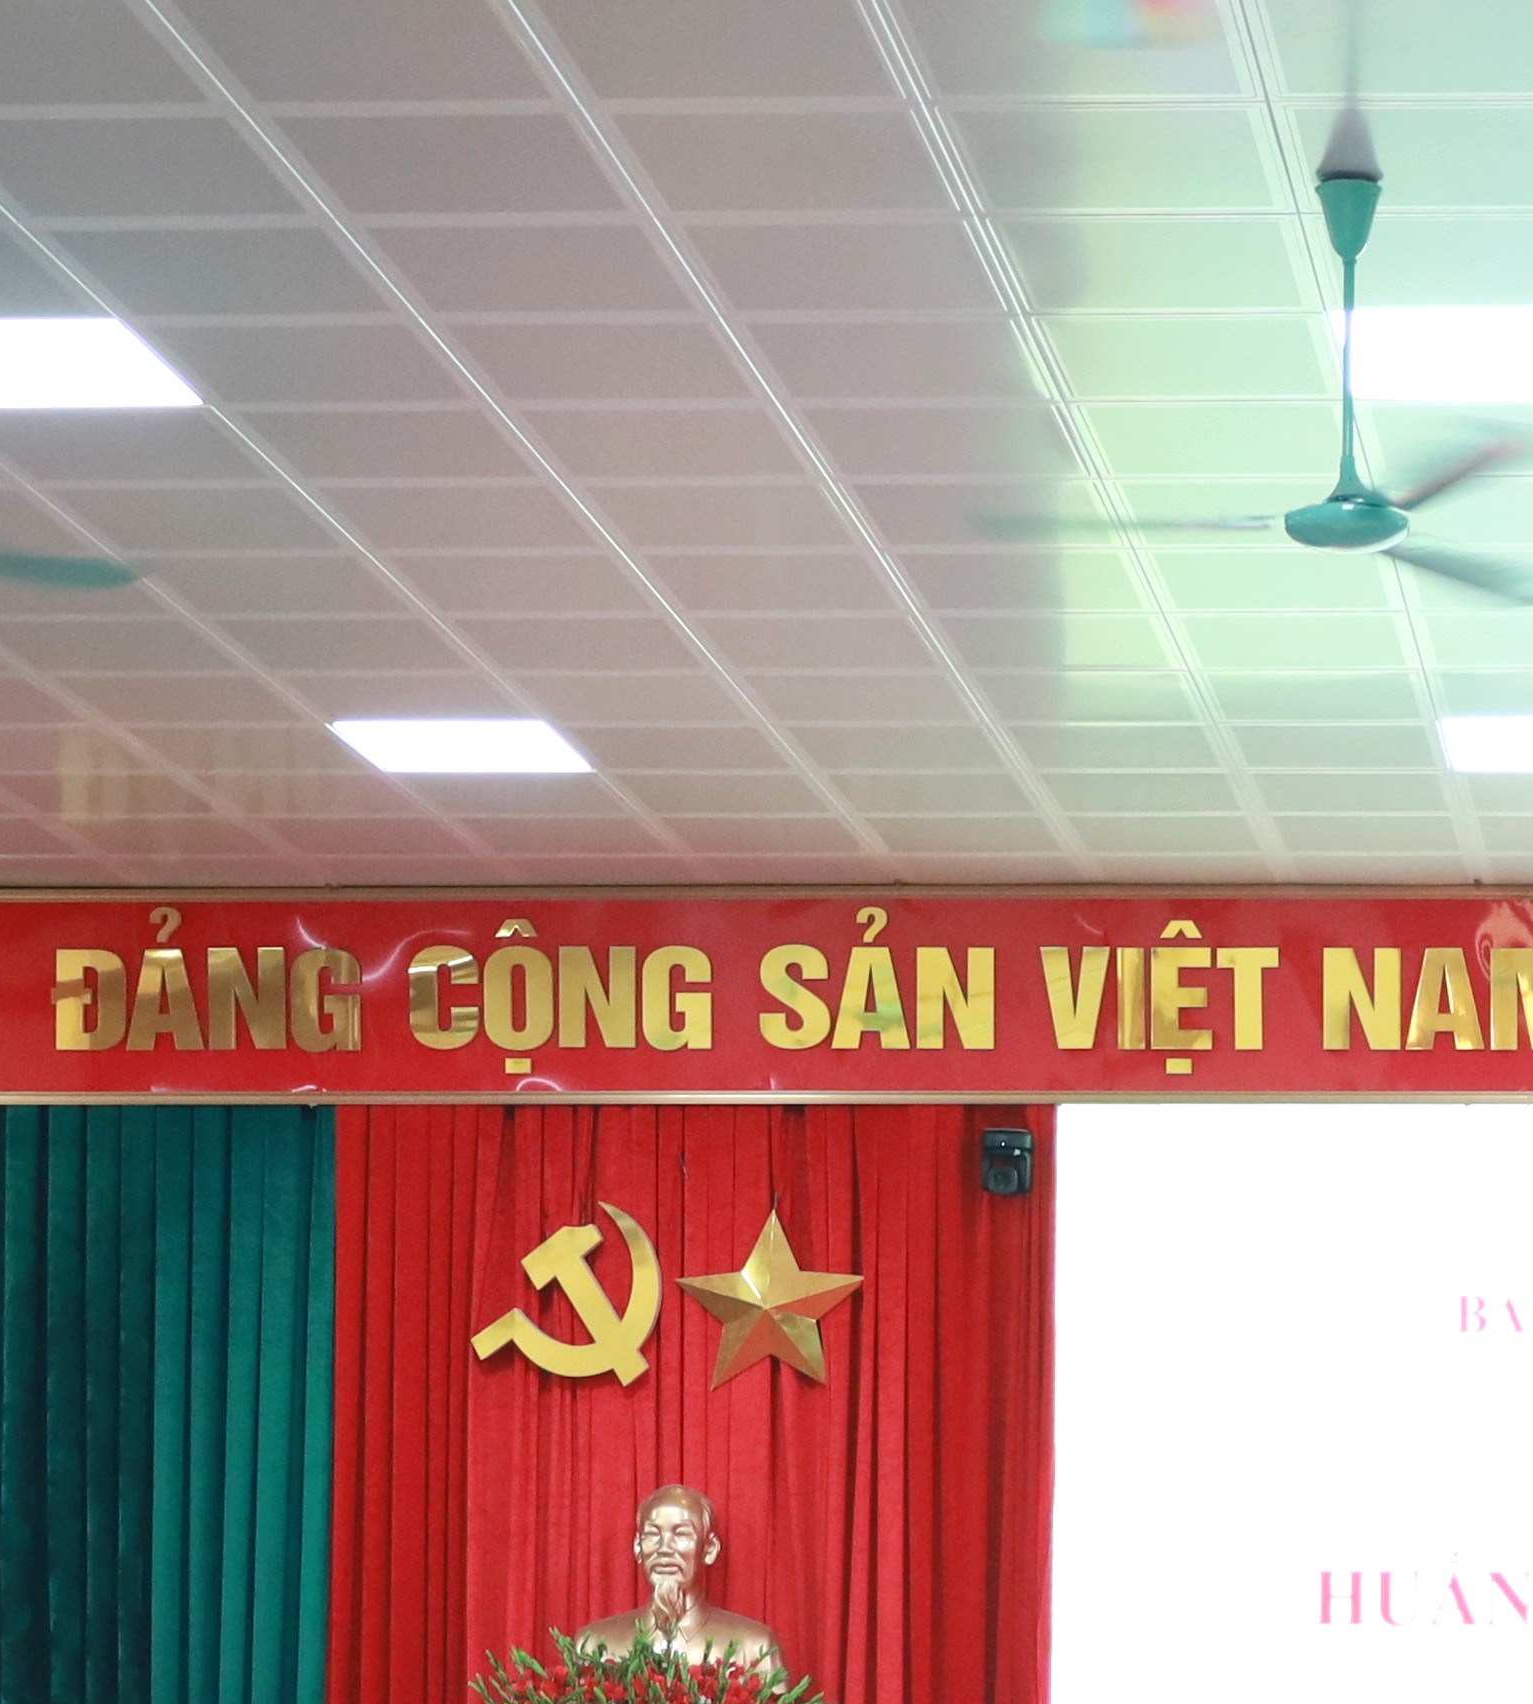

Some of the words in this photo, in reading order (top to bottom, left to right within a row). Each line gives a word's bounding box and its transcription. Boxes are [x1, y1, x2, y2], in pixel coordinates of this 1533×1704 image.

[50, 907, 362, 1054] ĐẢNG
[406, 918, 711, 1076] CỘNG
[759, 907, 995, 1052] SẢN
[1039, 918, 1281, 1077] VIỆT
